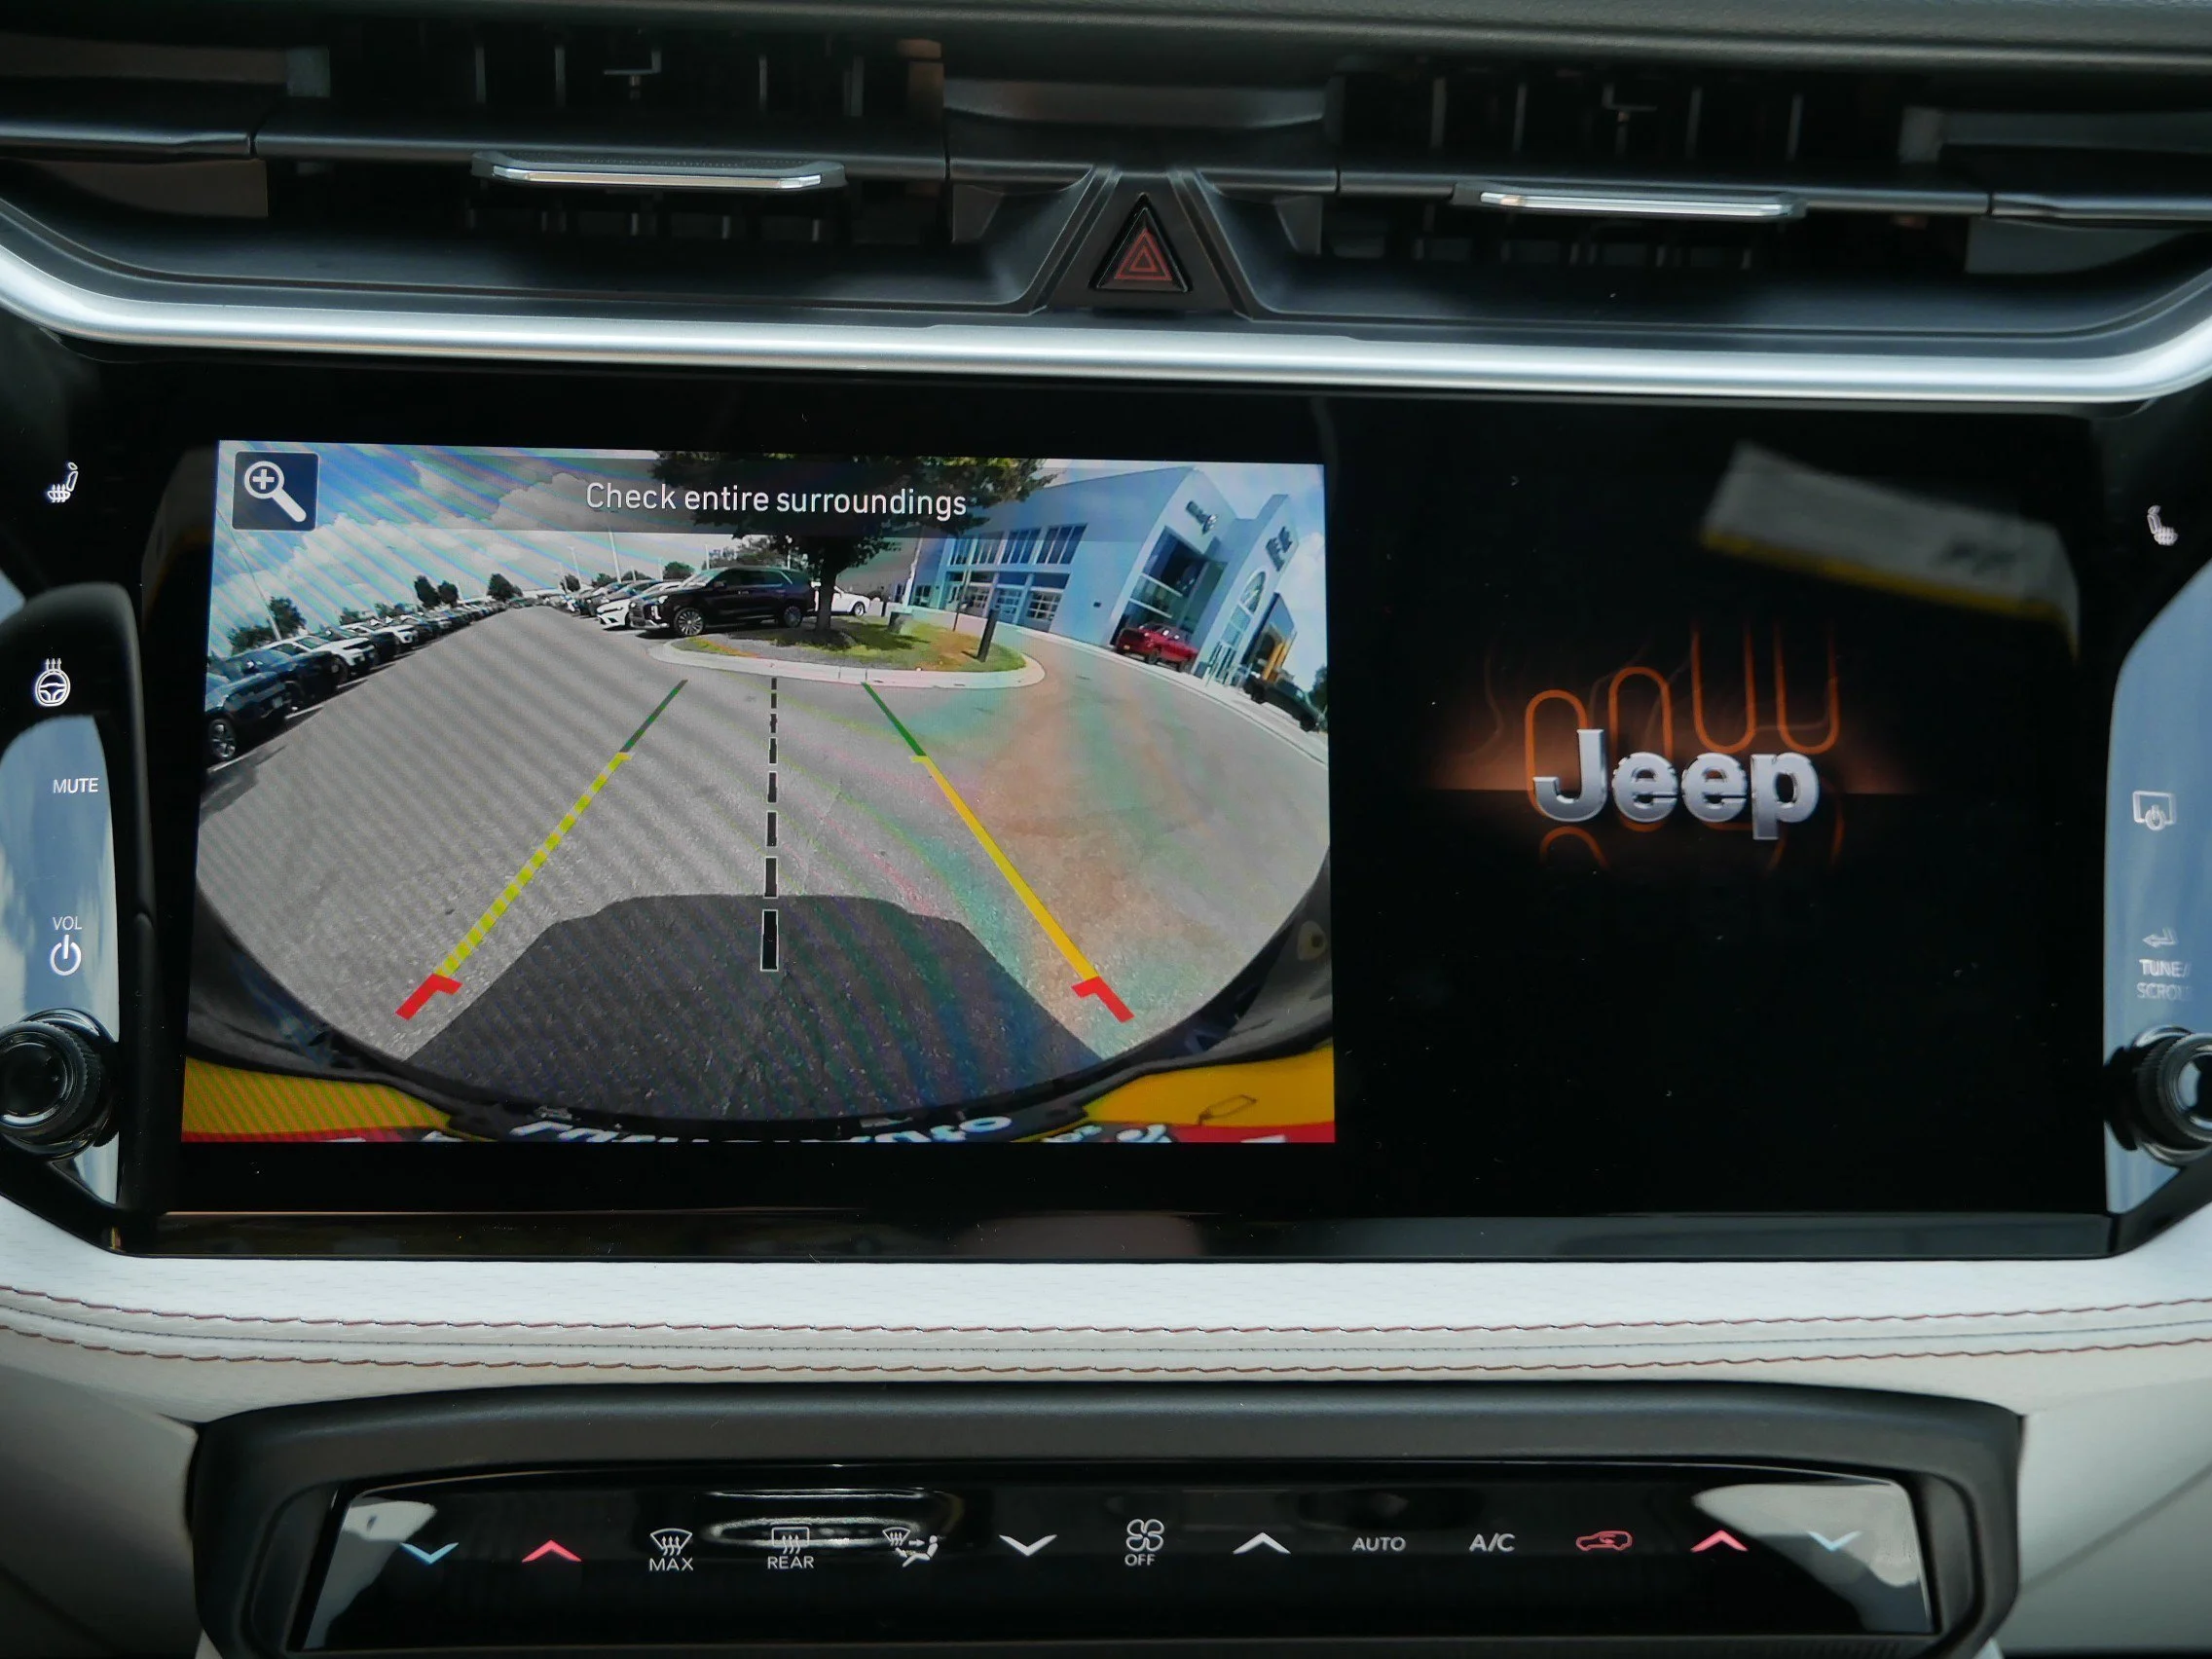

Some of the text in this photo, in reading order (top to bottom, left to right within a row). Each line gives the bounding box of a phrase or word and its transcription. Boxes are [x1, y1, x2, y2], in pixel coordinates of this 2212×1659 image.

[585, 481, 968, 522] Check entire surroundings
[53, 778, 99, 794] MUTE
[1532, 728, 1820, 840] Jeep
[52, 915, 83, 931] VOL
[1351, 1535, 1407, 1553] AUTO
[1468, 1532, 1517, 1554] A/C
[648, 1557, 694, 1572] MAX
[766, 1555, 815, 1570] REAR
[1124, 1553, 1157, 1567] OFF
